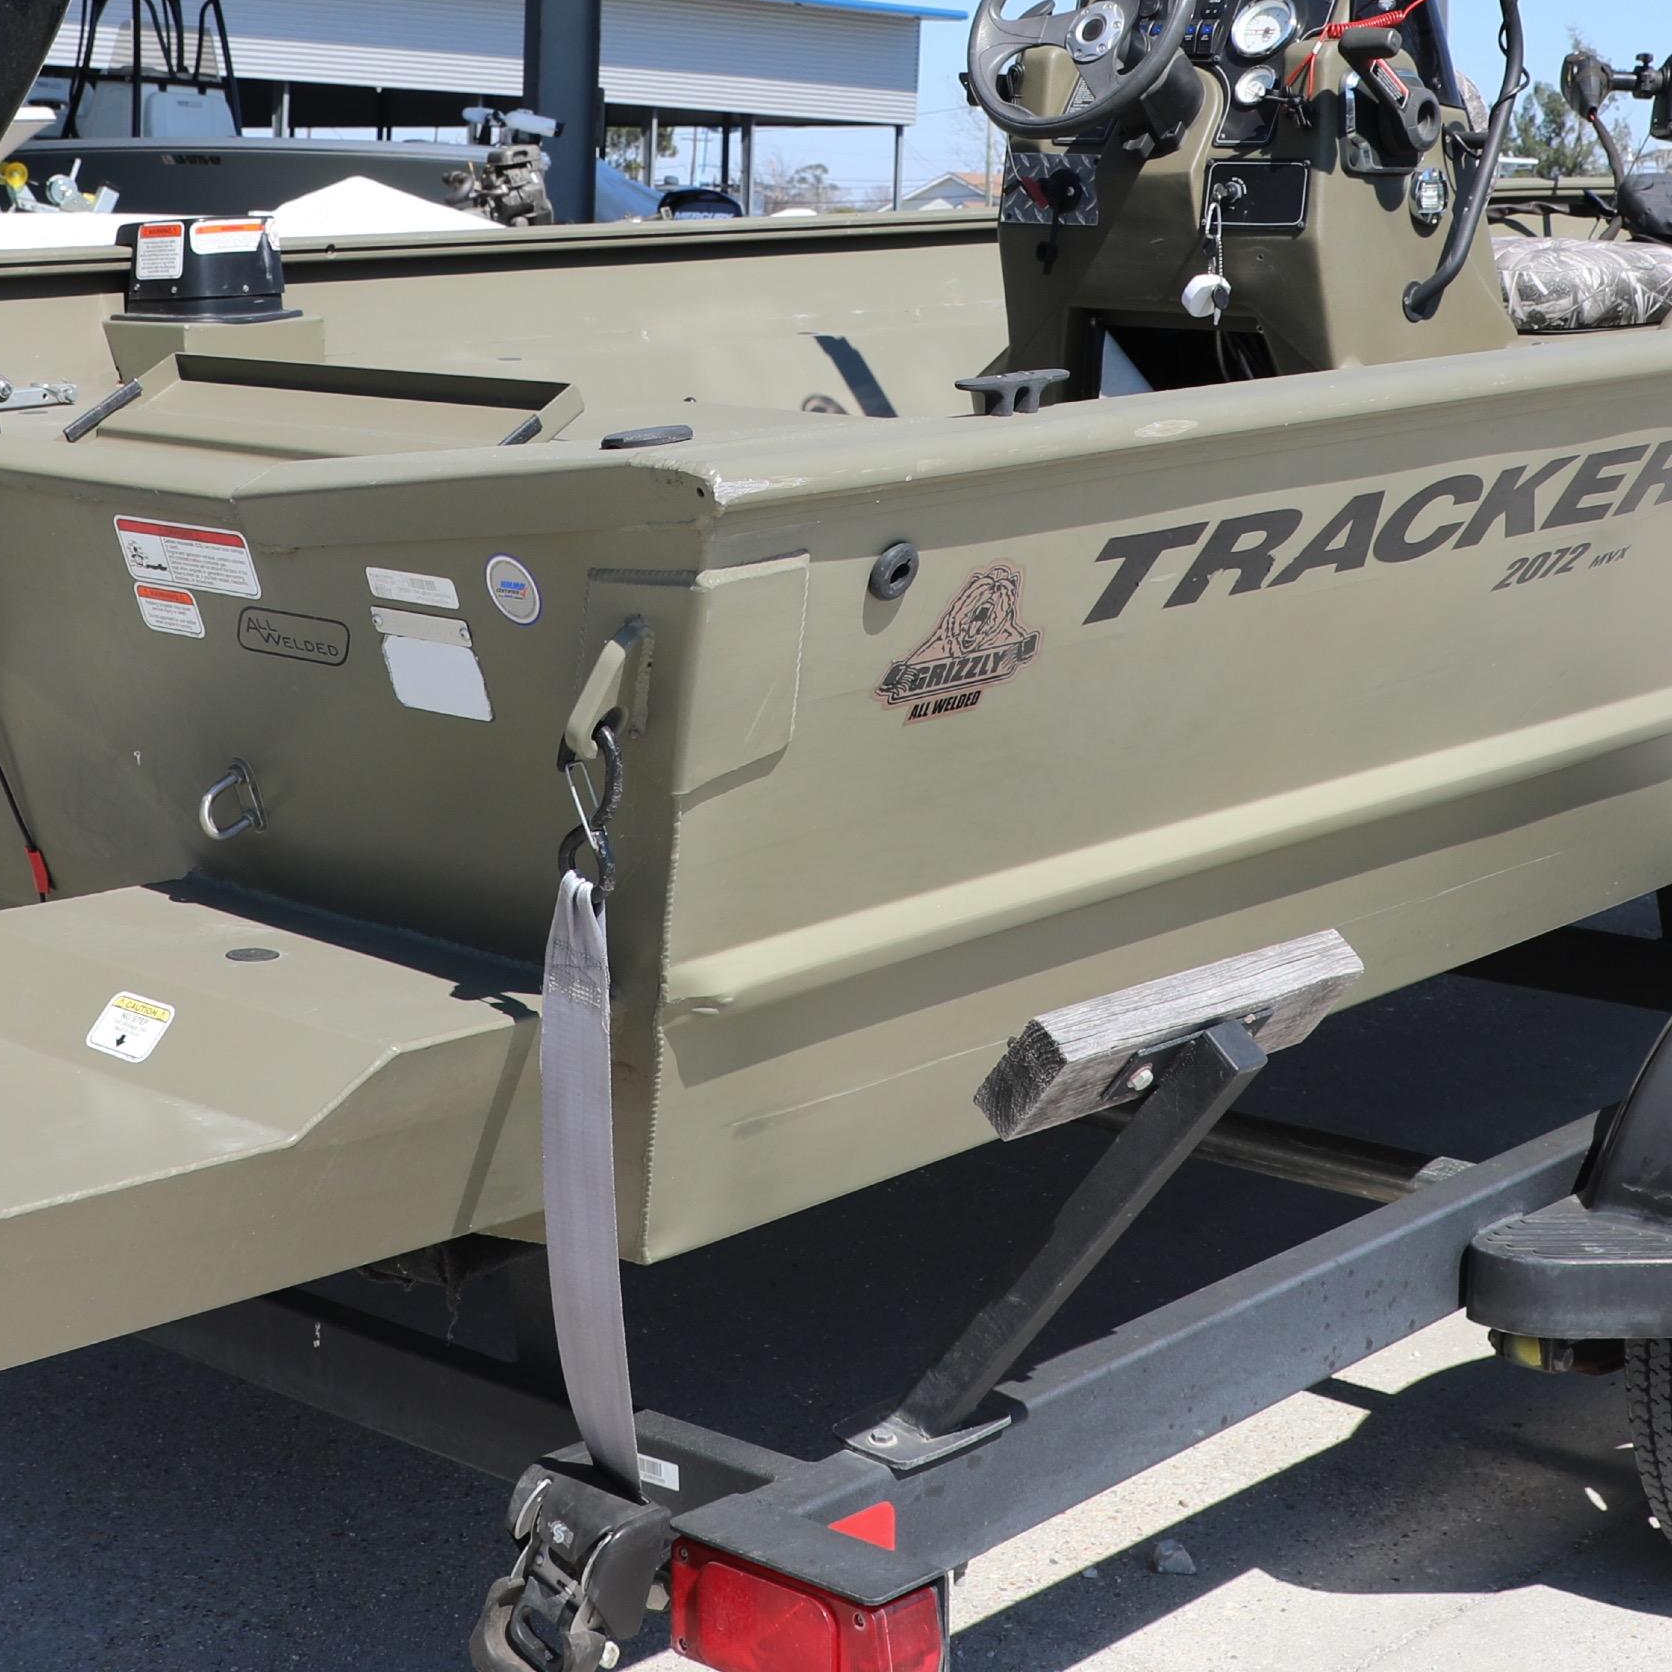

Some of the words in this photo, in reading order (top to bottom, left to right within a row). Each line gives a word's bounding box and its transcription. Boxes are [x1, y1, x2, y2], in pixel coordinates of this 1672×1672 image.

[1490, 542, 1594, 592] 2072
[1587, 544, 1633, 570] MVX
[246, 616, 279, 632] ALL
[257, 628, 340, 657] WELDED
[911, 649, 1007, 691] GRIZZLY
[907, 702, 930, 721] ALL
[931, 690, 982, 715] WELDED
[125, 1001, 158, 1016] CAUTION
